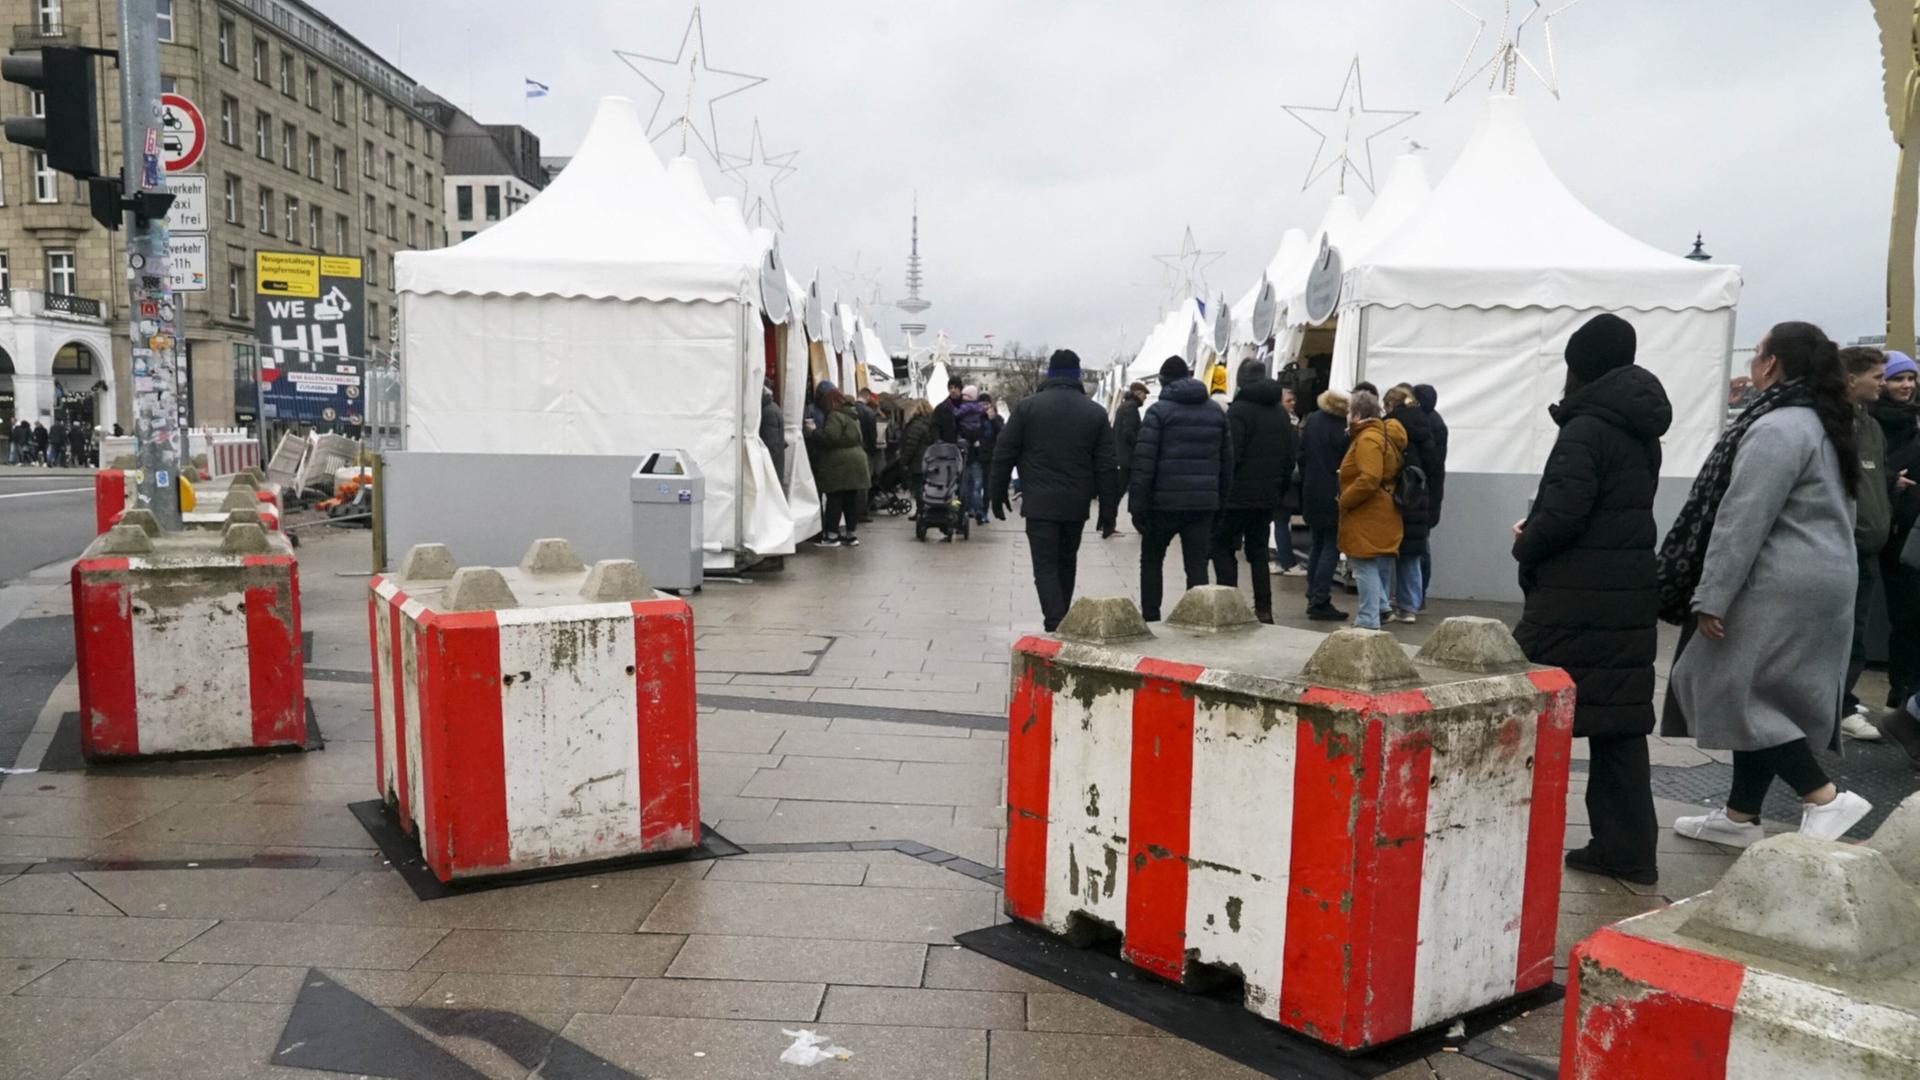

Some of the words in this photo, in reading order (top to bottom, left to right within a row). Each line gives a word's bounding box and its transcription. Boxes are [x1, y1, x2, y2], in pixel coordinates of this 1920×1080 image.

[168, 183, 202, 194] verkehr
[173, 198, 191, 209] axi
[181, 213, 201, 224] frei
[169, 243, 201, 254] verkehr
[169, 258, 191, 269] -11h
[169, 274, 185, 284] rei
[267, 300, 306, 319] WE
[271, 323, 349, 363] HH
